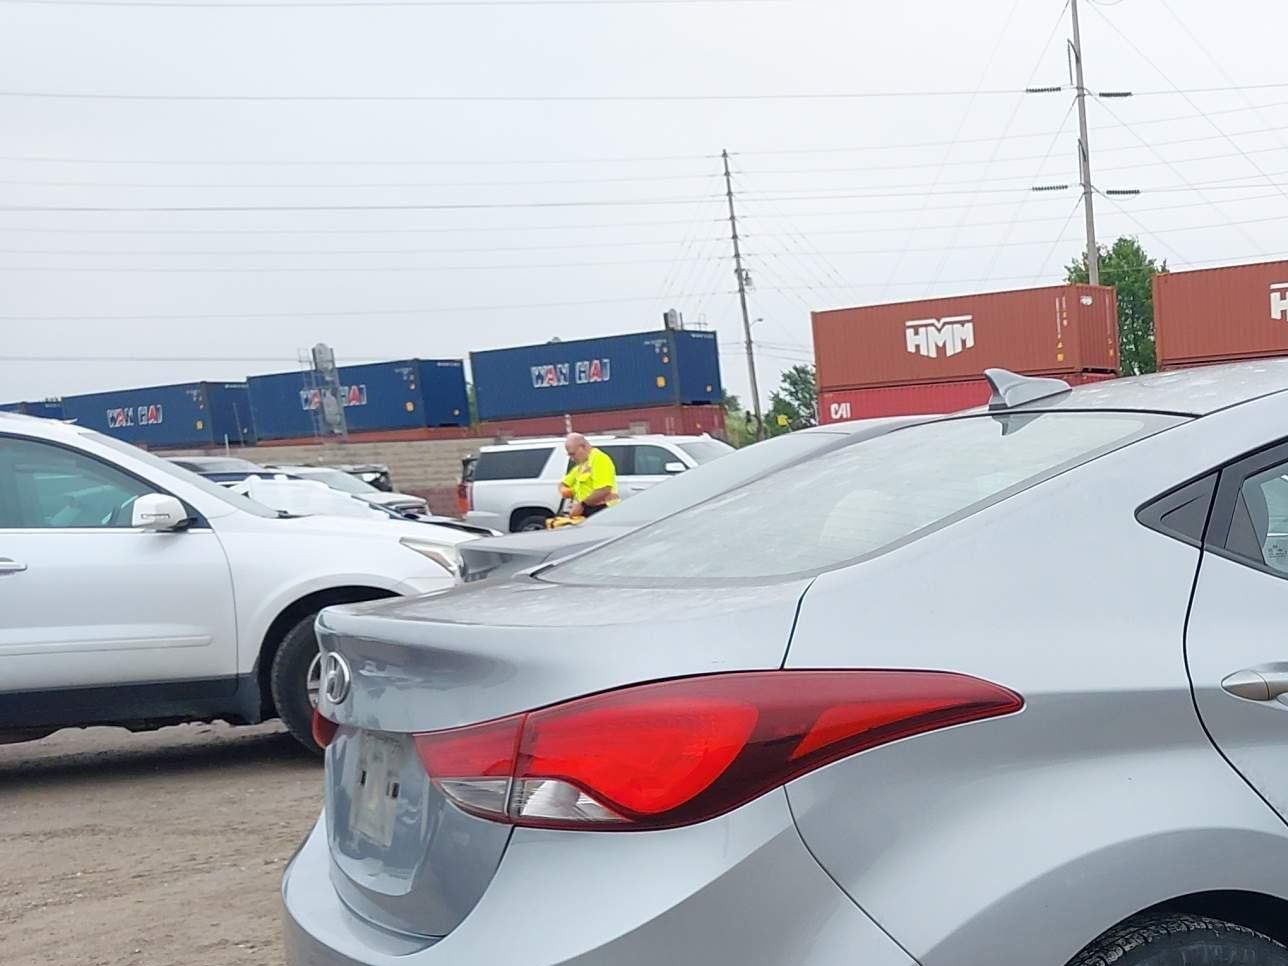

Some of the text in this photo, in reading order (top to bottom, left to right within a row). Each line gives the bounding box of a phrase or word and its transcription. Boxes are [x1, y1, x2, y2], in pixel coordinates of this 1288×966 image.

[905, 314, 975, 358] HMM
[531, 359, 610, 388] WAN HAI
[106, 407, 135, 428] WAN
[830, 402, 851, 419] CAI
